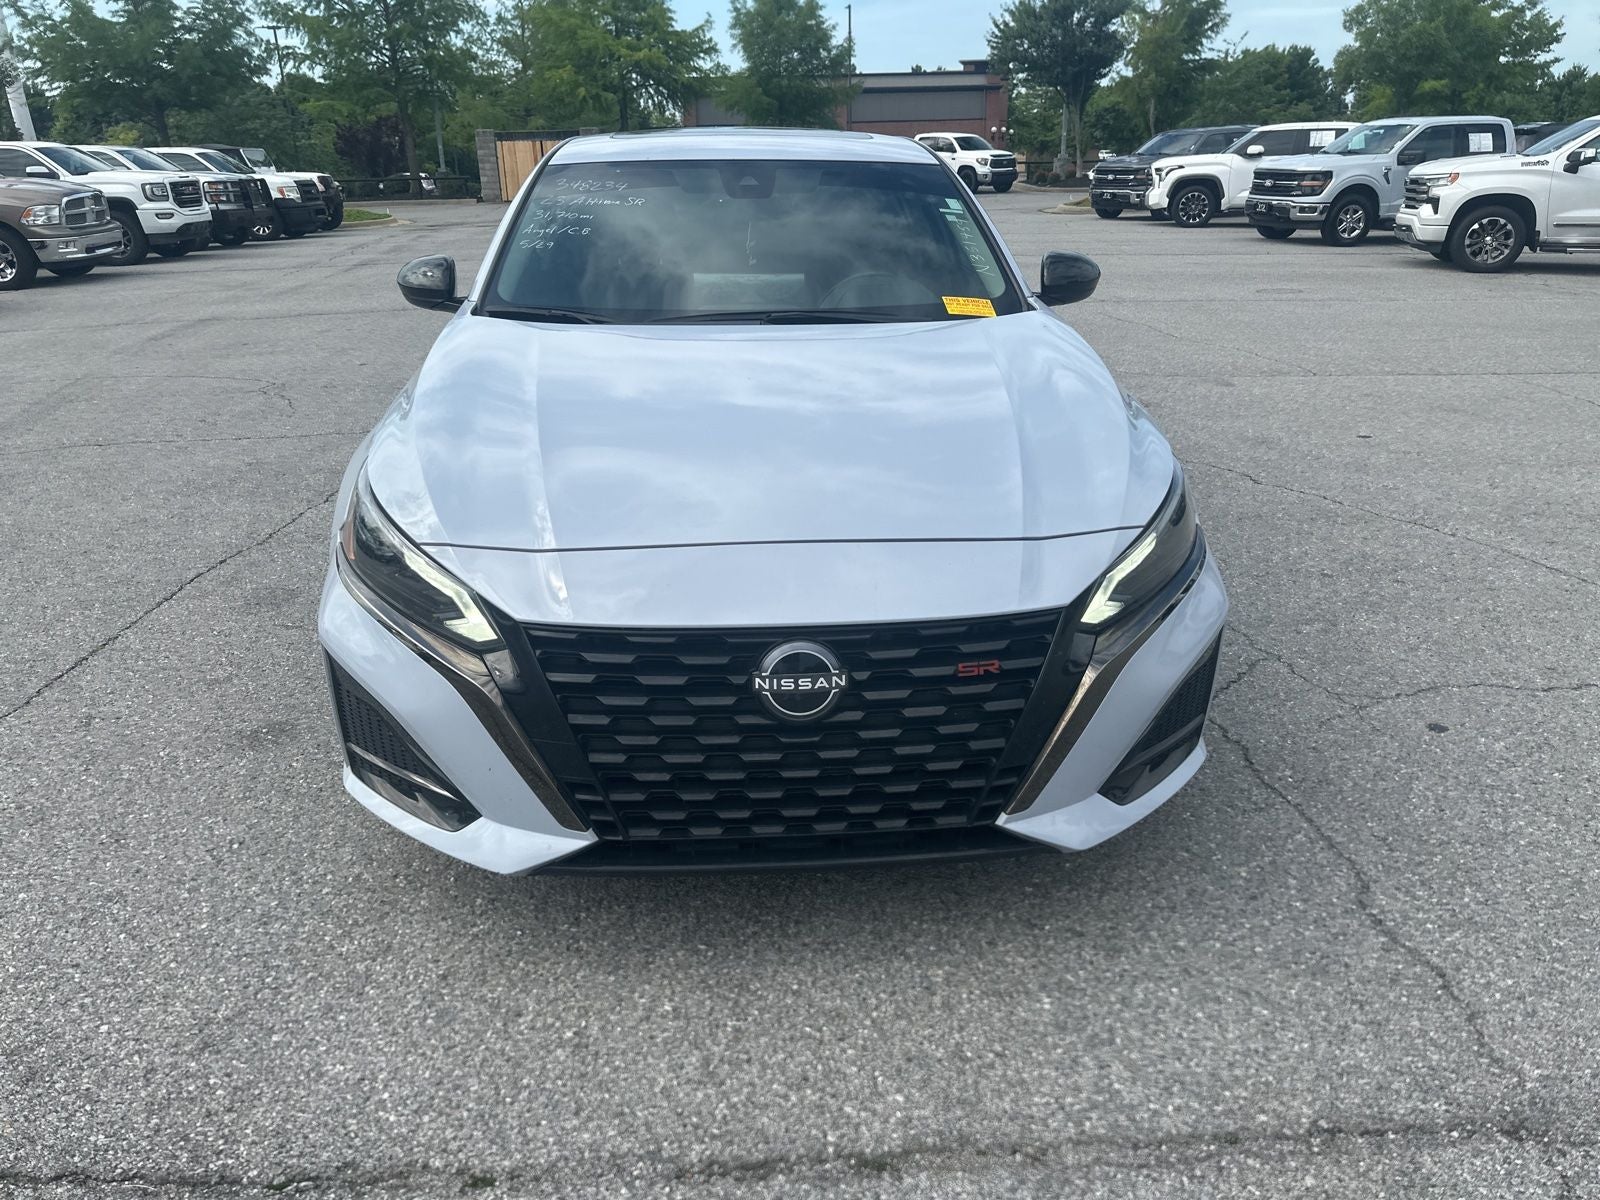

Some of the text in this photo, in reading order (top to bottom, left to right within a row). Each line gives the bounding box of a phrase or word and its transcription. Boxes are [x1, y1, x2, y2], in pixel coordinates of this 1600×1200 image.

[556, 178, 628, 192] 348234
[624, 196, 646, 207] SR
[534, 210, 579, 221] 31,710
[519, 239, 554, 249] 5/29
[957, 659, 1000, 677] SR
[754, 674, 846, 690] NISSAN
